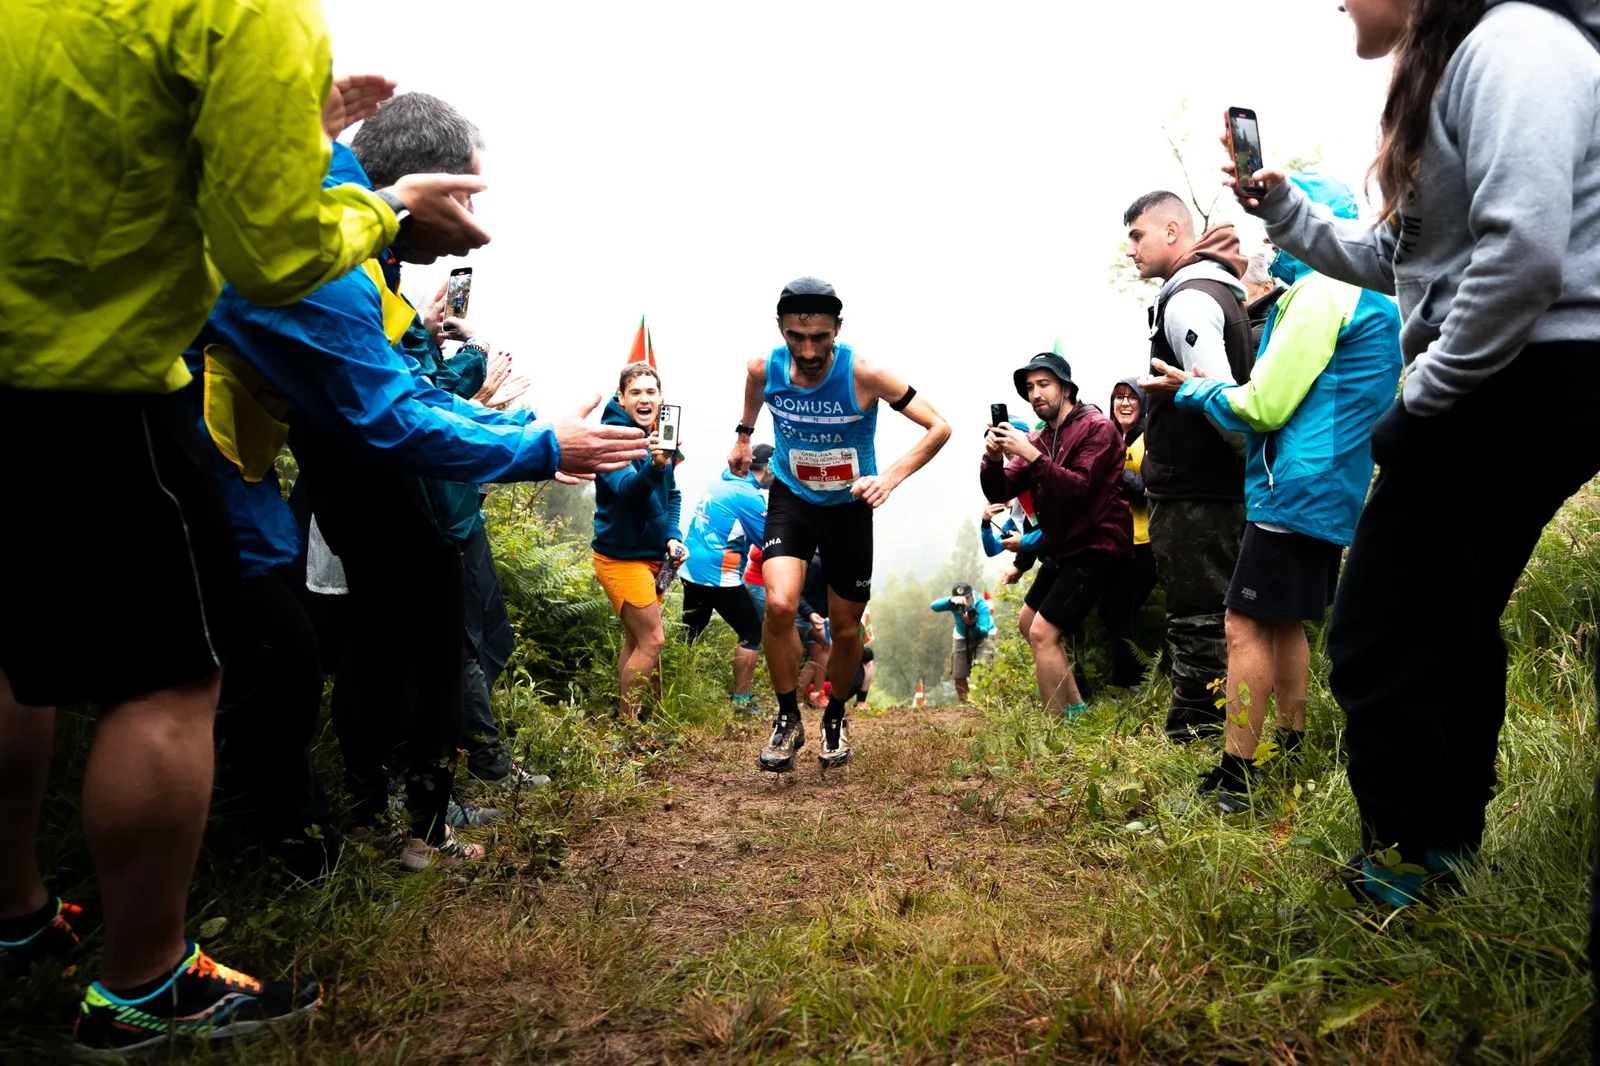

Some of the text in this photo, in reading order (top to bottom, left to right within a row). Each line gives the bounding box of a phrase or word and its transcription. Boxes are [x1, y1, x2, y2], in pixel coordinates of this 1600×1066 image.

[774, 395, 844, 414] DOMUSA
[799, 432, 843, 443] LANA
[820, 468, 827, 476] 5
